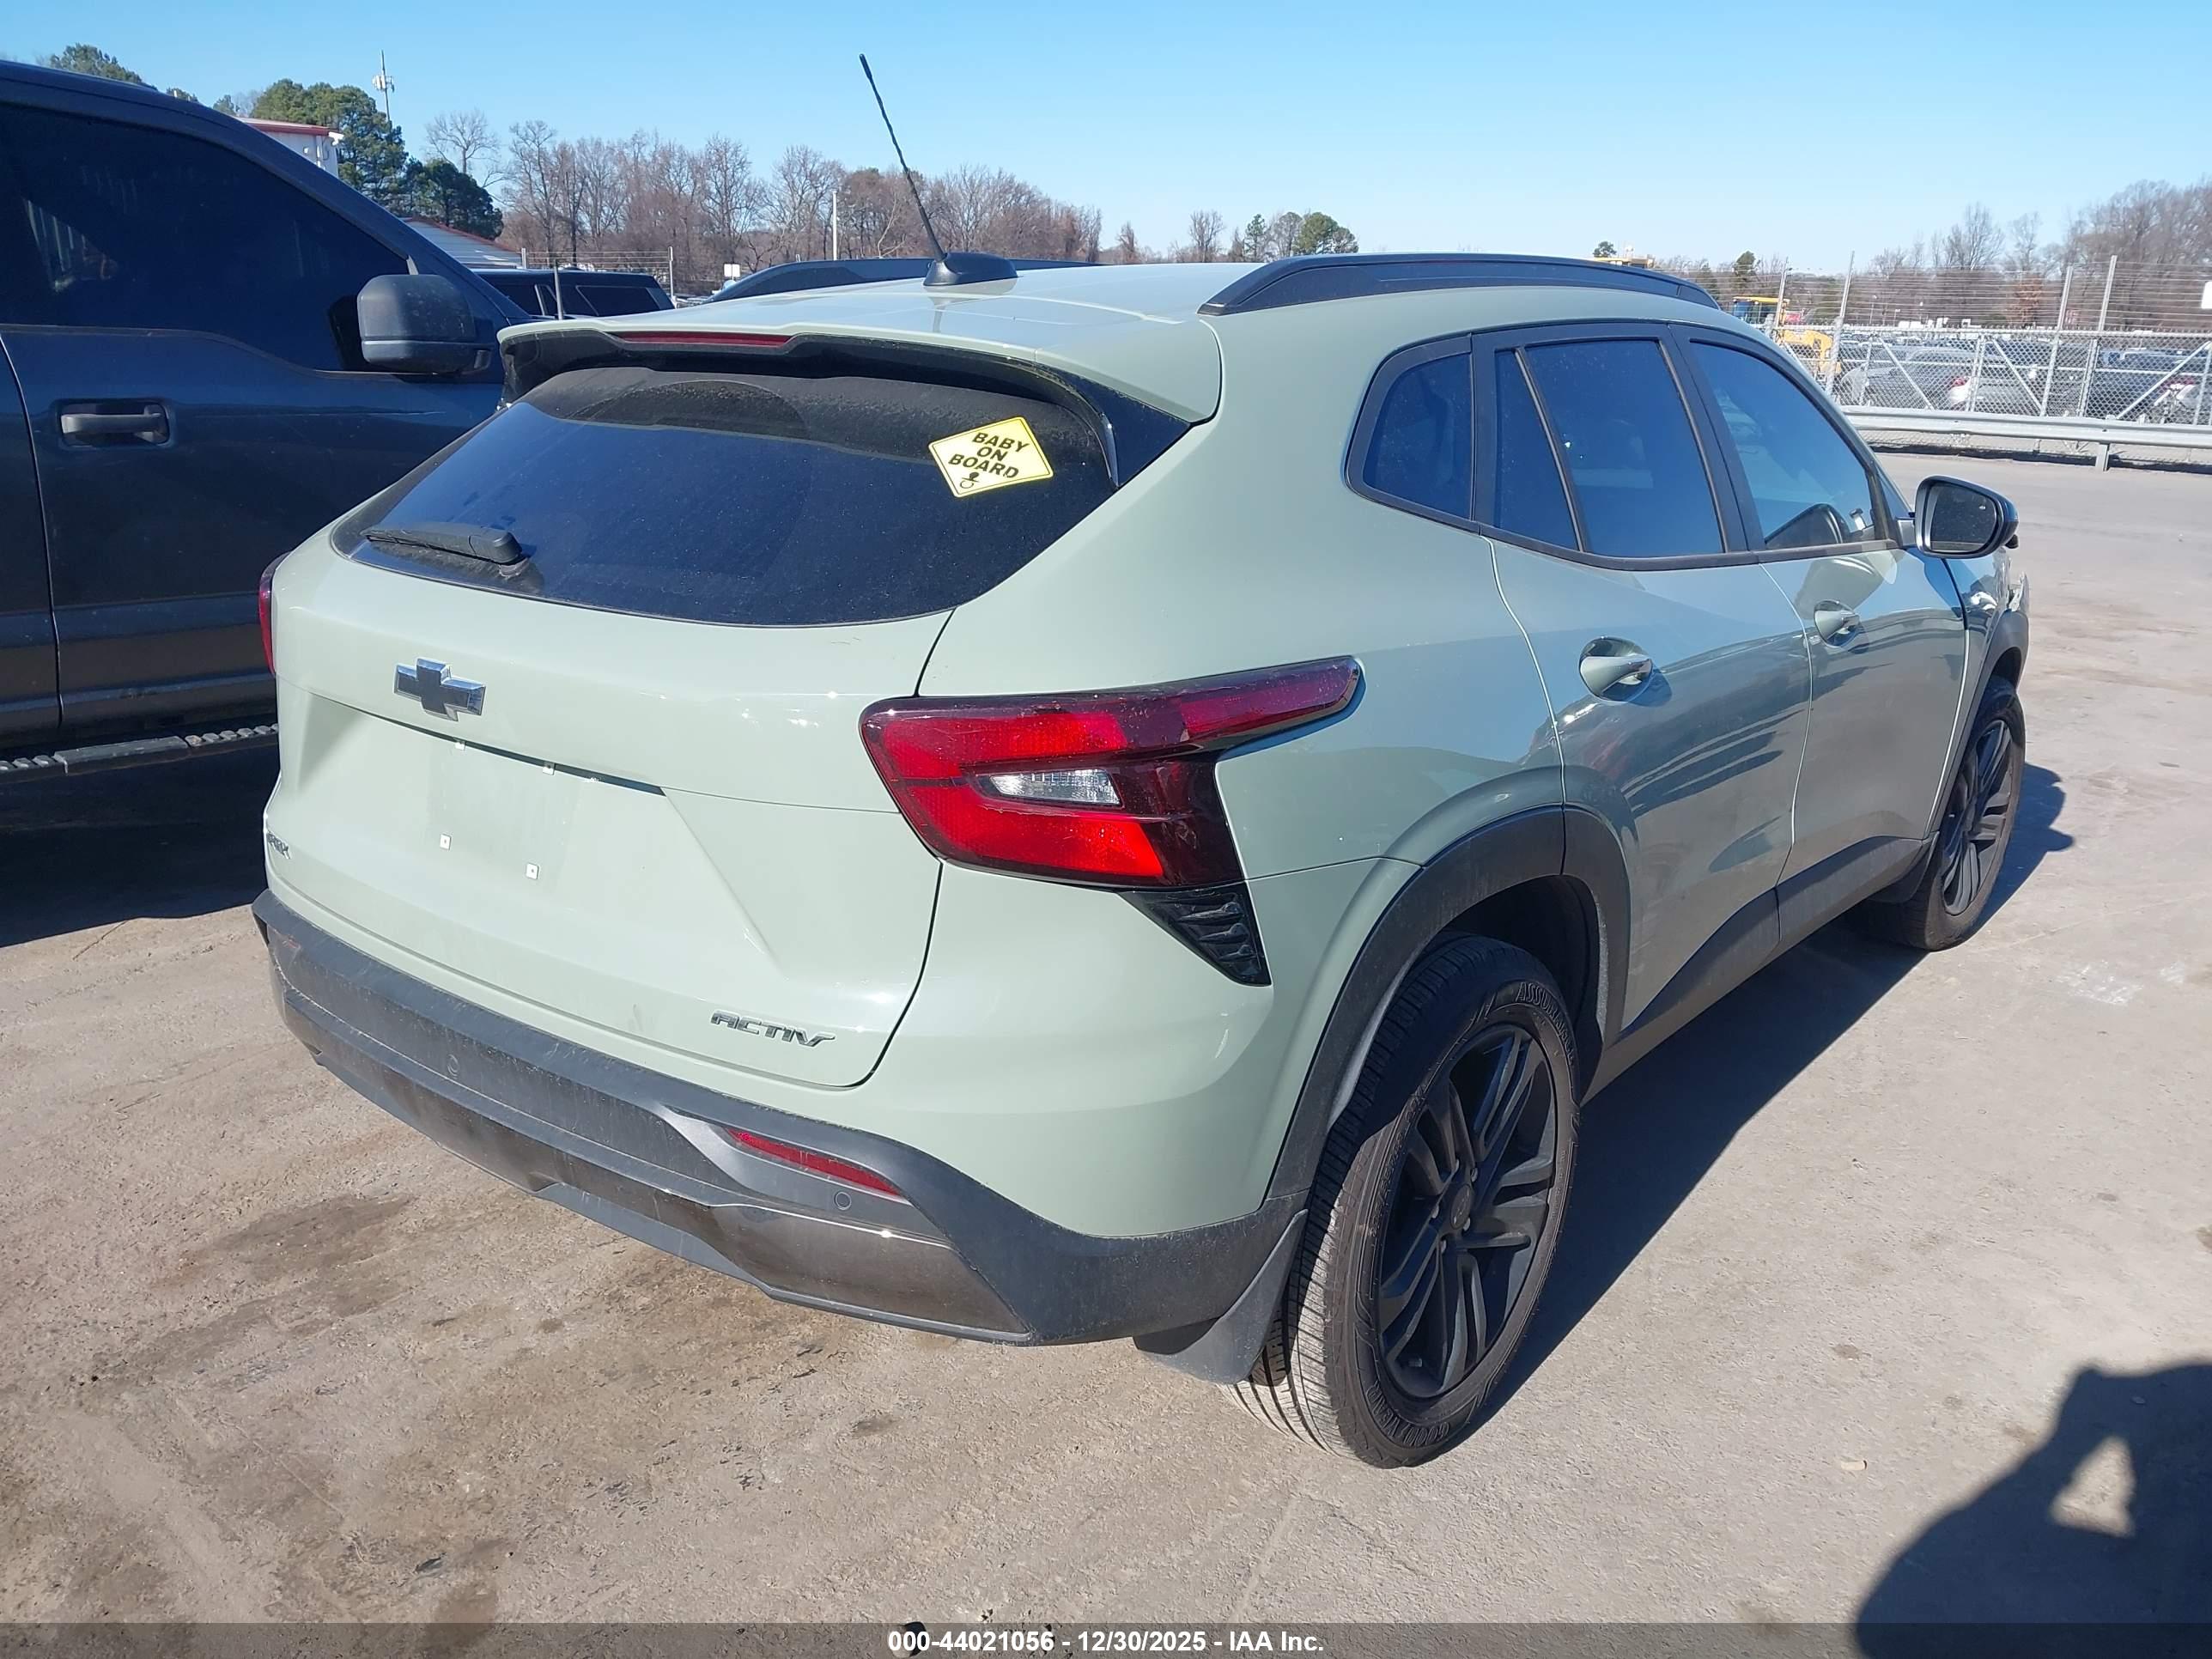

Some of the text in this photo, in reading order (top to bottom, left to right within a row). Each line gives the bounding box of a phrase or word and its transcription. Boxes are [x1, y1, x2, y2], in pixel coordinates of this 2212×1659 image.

[972, 432, 1030, 453] BABY
[976, 446, 1008, 462] ON
[948, 453, 1019, 478] BOARD
[710, 1009, 836, 1048] ACTIV
[1366, 1380, 1449, 1447] GOODYEAR
